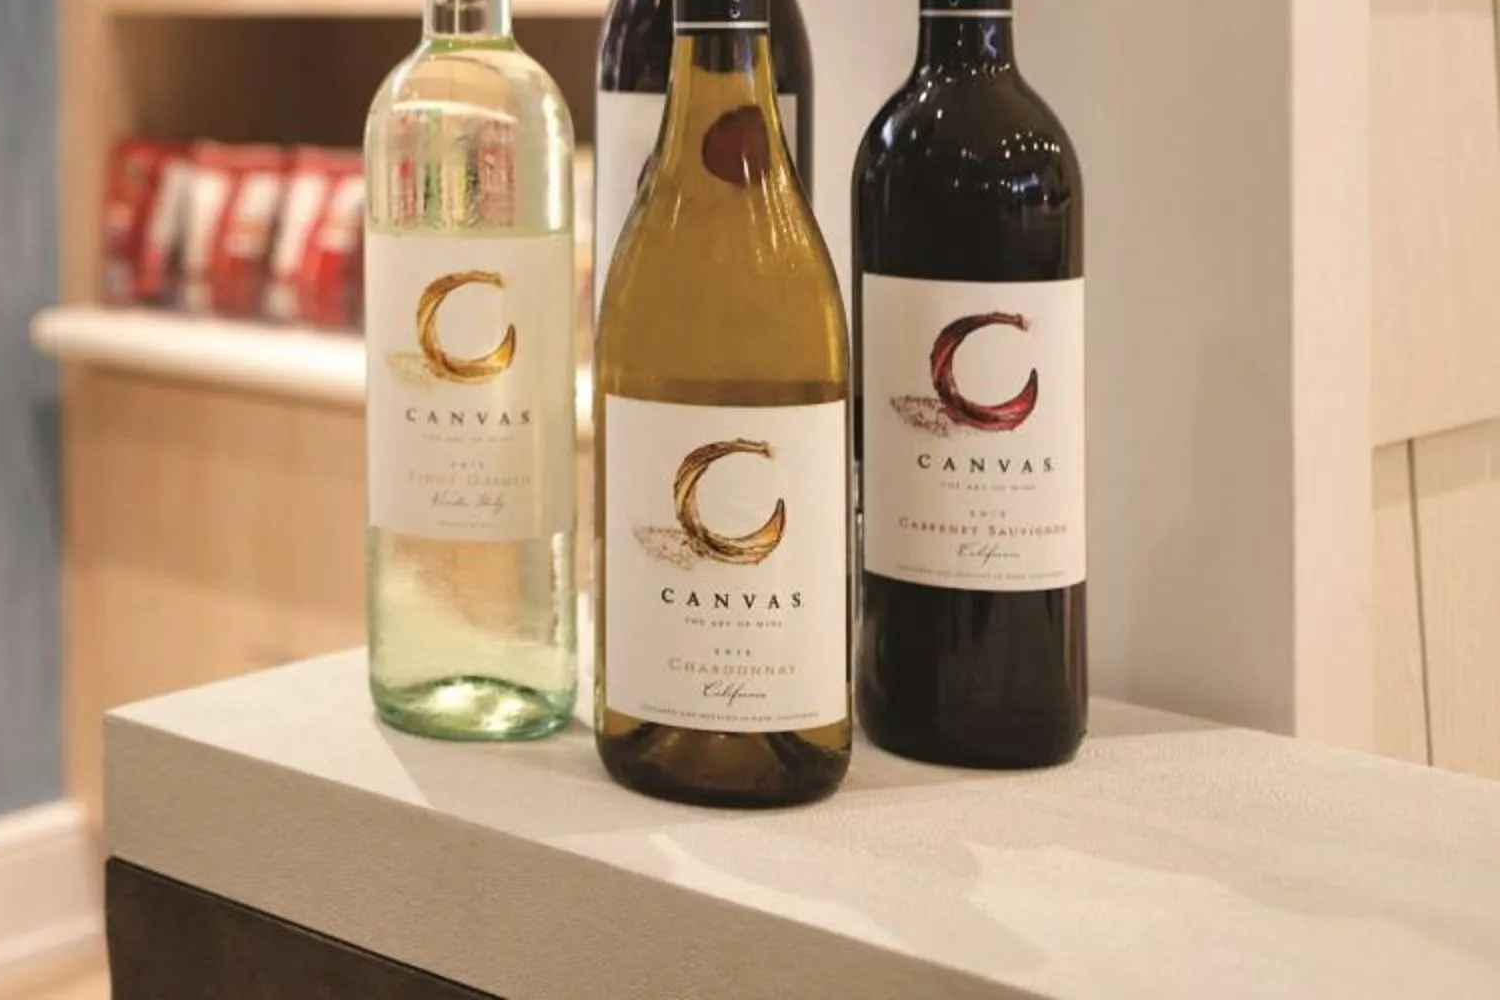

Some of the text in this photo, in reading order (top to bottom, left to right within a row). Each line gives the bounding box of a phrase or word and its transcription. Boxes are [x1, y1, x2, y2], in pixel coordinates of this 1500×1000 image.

[404, 407, 534, 426] CANVAS
[916, 453, 1054, 474] CANVAS
[660, 587, 802, 609] CANVAS
[667, 657, 797, 677] CHARDONNAY
